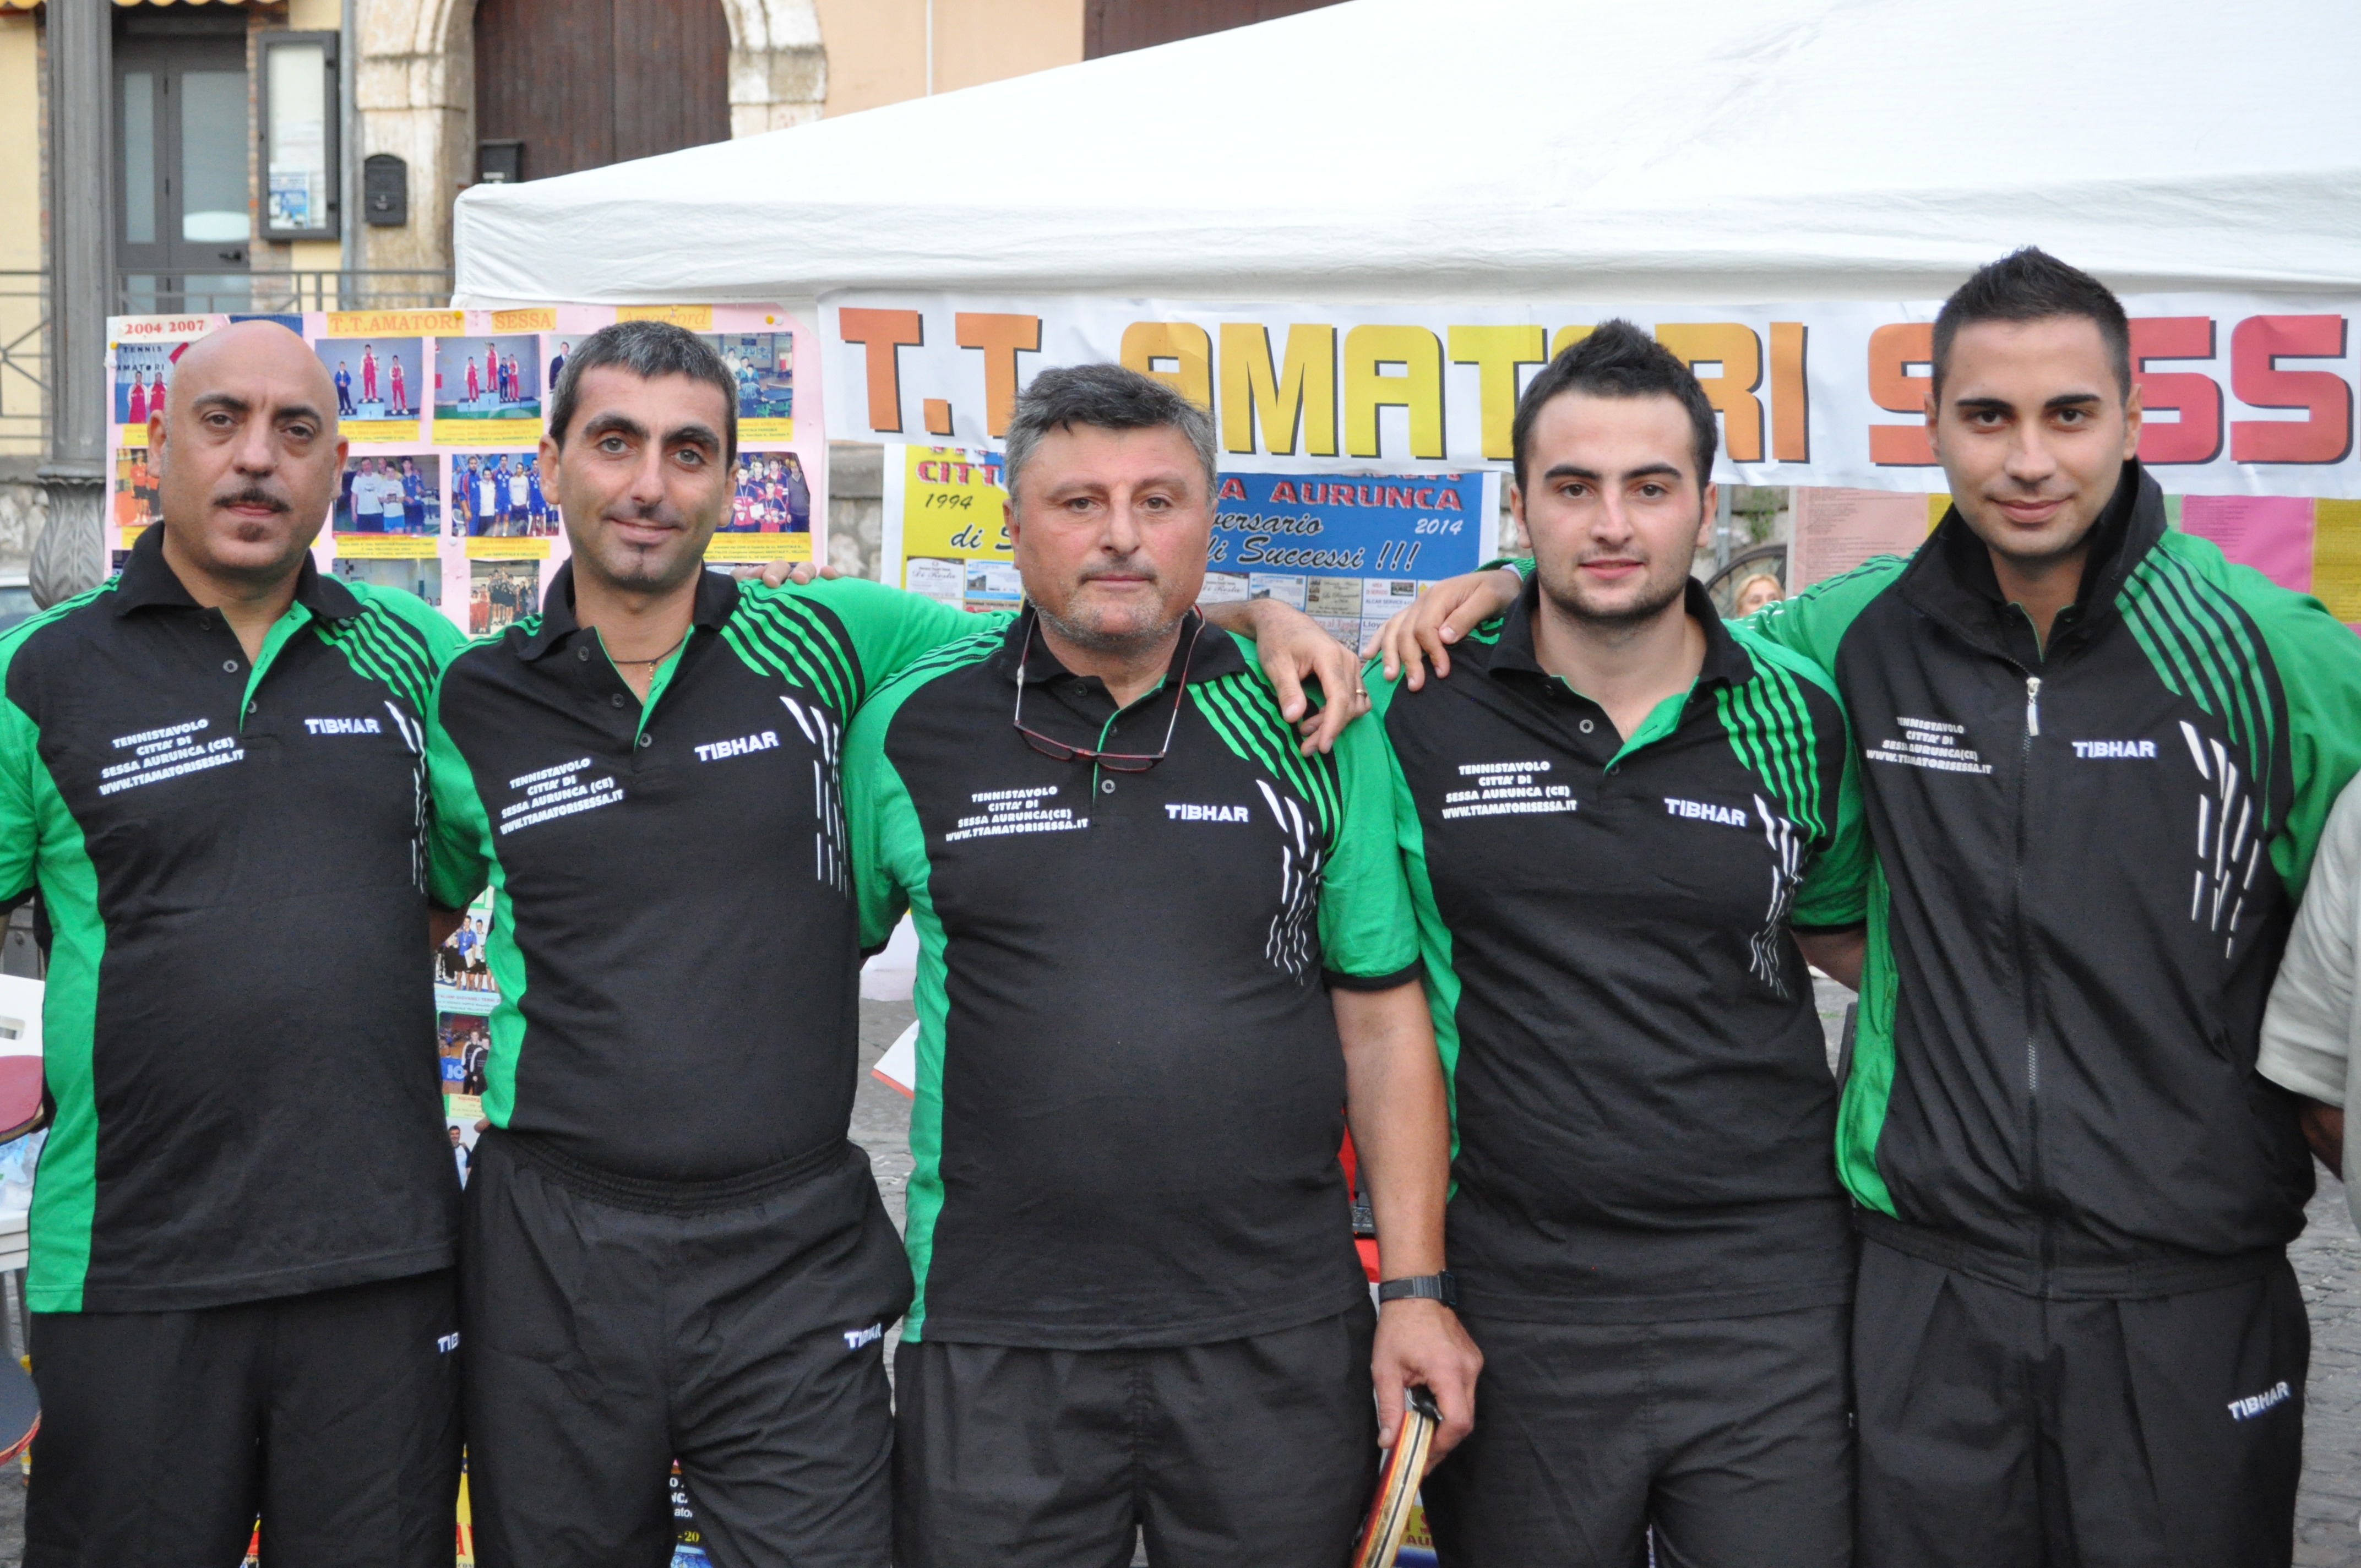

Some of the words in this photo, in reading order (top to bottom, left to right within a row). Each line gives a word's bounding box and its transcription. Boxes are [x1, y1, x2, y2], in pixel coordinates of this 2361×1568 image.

[125, 323, 162, 335] 2004
[168, 320, 204, 333] 2007
[494, 313, 552, 329] SESSA
[1120, 321, 1810, 465] AMATRI
[1868, 314, 2361, 467] SSS
[916, 460, 1001, 486] CITT
[1270, 481, 1463, 511] AURUNCA
[925, 493, 973, 510] 1994
[1213, 512, 1323, 536] versario
[1414, 518, 1463, 536] 2014
[950, 524, 983, 548] di
[1237, 534, 1365, 569] Successi
[1375, 540, 1421, 571] !!!
[1363, 620, 1383, 629] Lloy
[112, 718, 209, 749] TENNISTAVOLO
[304, 718, 381, 734] TIBHAR
[176, 736, 193, 747] DI
[694, 731, 780, 761] TIBHAR
[1941, 736, 1954, 745] DI
[2071, 741, 2155, 758] TIBHAR
[101, 760, 141, 778] SESSA
[143, 745, 206, 769] AURUNCA
[208, 737, 235, 753] (CE)
[1459, 760, 1551, 775] TENNISTAVOLO
[99, 749, 244, 796] WWW.TTAMATORISESSA.IT
[509, 758, 591, 790] TENNISTAVOLO
[562, 775, 576, 787] DI
[1517, 775, 1532, 785] DI
[501, 802, 530, 819] SESSA
[531, 785, 588, 809] AURUNCA
[590, 776, 614, 794] (CE)
[971, 786, 1058, 803] TENNISTAVOLO
[1025, 799, 1038, 809] DI
[1445, 790, 1480, 803] SESSA
[1482, 787, 1542, 799] AURUNCA
[1545, 785, 1570, 798] (CE)
[499, 789, 624, 836] WWW.TTAMATORISESSA.IT
[1165, 804, 1249, 823] TIBHAR
[1441, 799, 1577, 820] WWW.TTAMATORISESSA.IT
[1664, 798, 1746, 827] TIBHAR
[945, 818, 1089, 842] WWW.TTAMATORISESSA.IT
[958, 815, 988, 828] SESSA
[2227, 1381, 2291, 1420] TIBHAR
